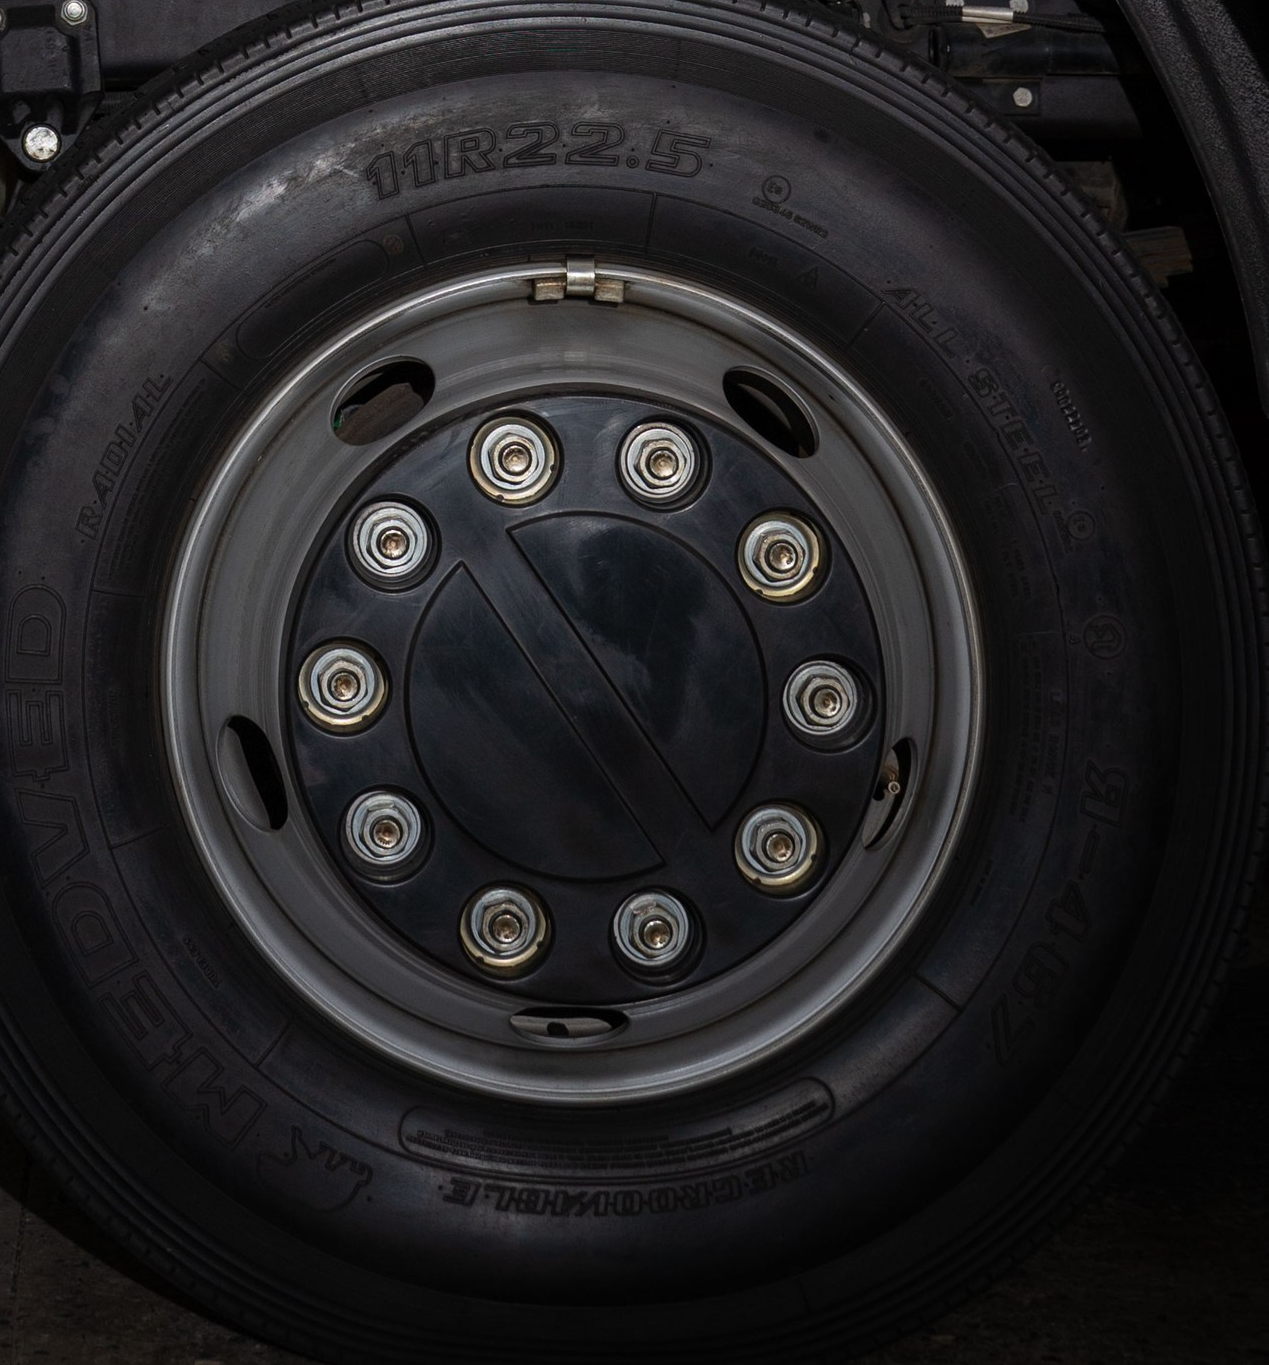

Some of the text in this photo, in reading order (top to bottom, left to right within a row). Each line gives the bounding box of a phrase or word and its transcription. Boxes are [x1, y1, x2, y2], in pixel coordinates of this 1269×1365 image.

[364, 121, 712, 202] 11R22.5
[75, 371, 174, 542] RADIAL
[882, 283, 968, 364] ALL
[968, 367, 1056, 517] STEEL
[4, 582, 269, 1152] MEDVED
[988, 760, 1132, 1071] Я-467
[443, 1149, 811, 1219] REGROOVABLE
